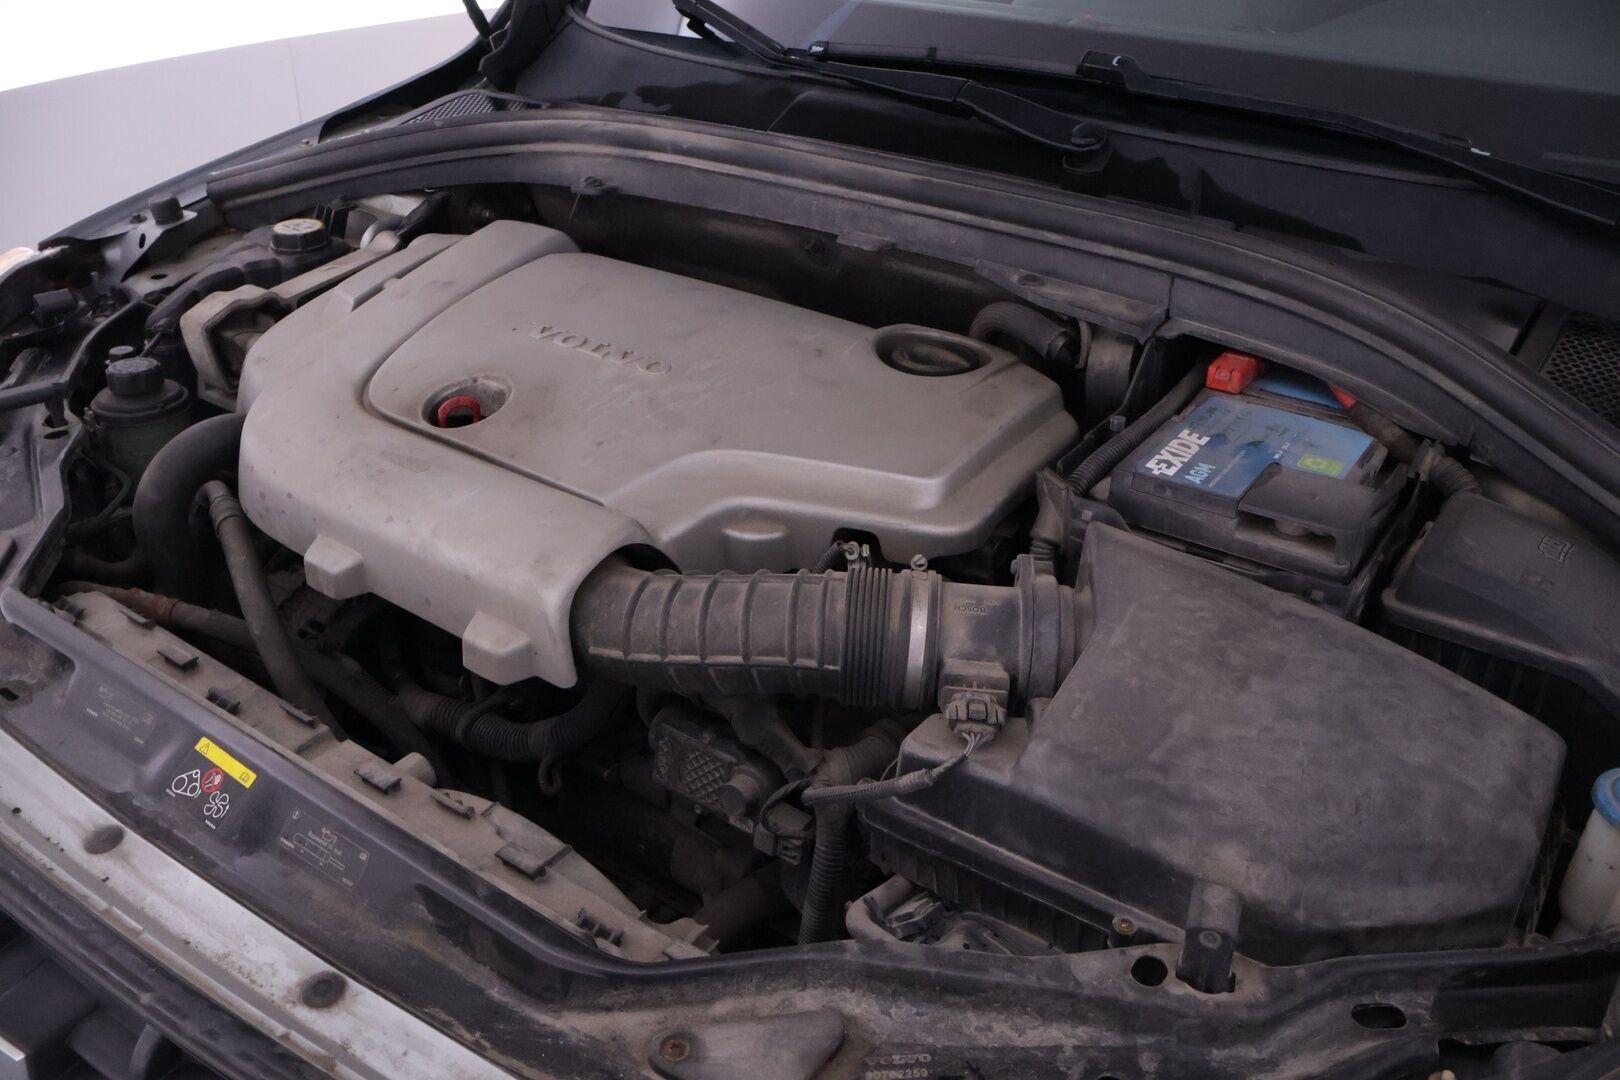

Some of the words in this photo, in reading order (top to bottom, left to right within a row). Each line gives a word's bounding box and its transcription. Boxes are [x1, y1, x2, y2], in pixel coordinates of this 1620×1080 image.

[531, 322, 672, 375] VOLVO
[1145, 429, 1211, 477] EXIDE
[1184, 462, 1216, 485] AGM
